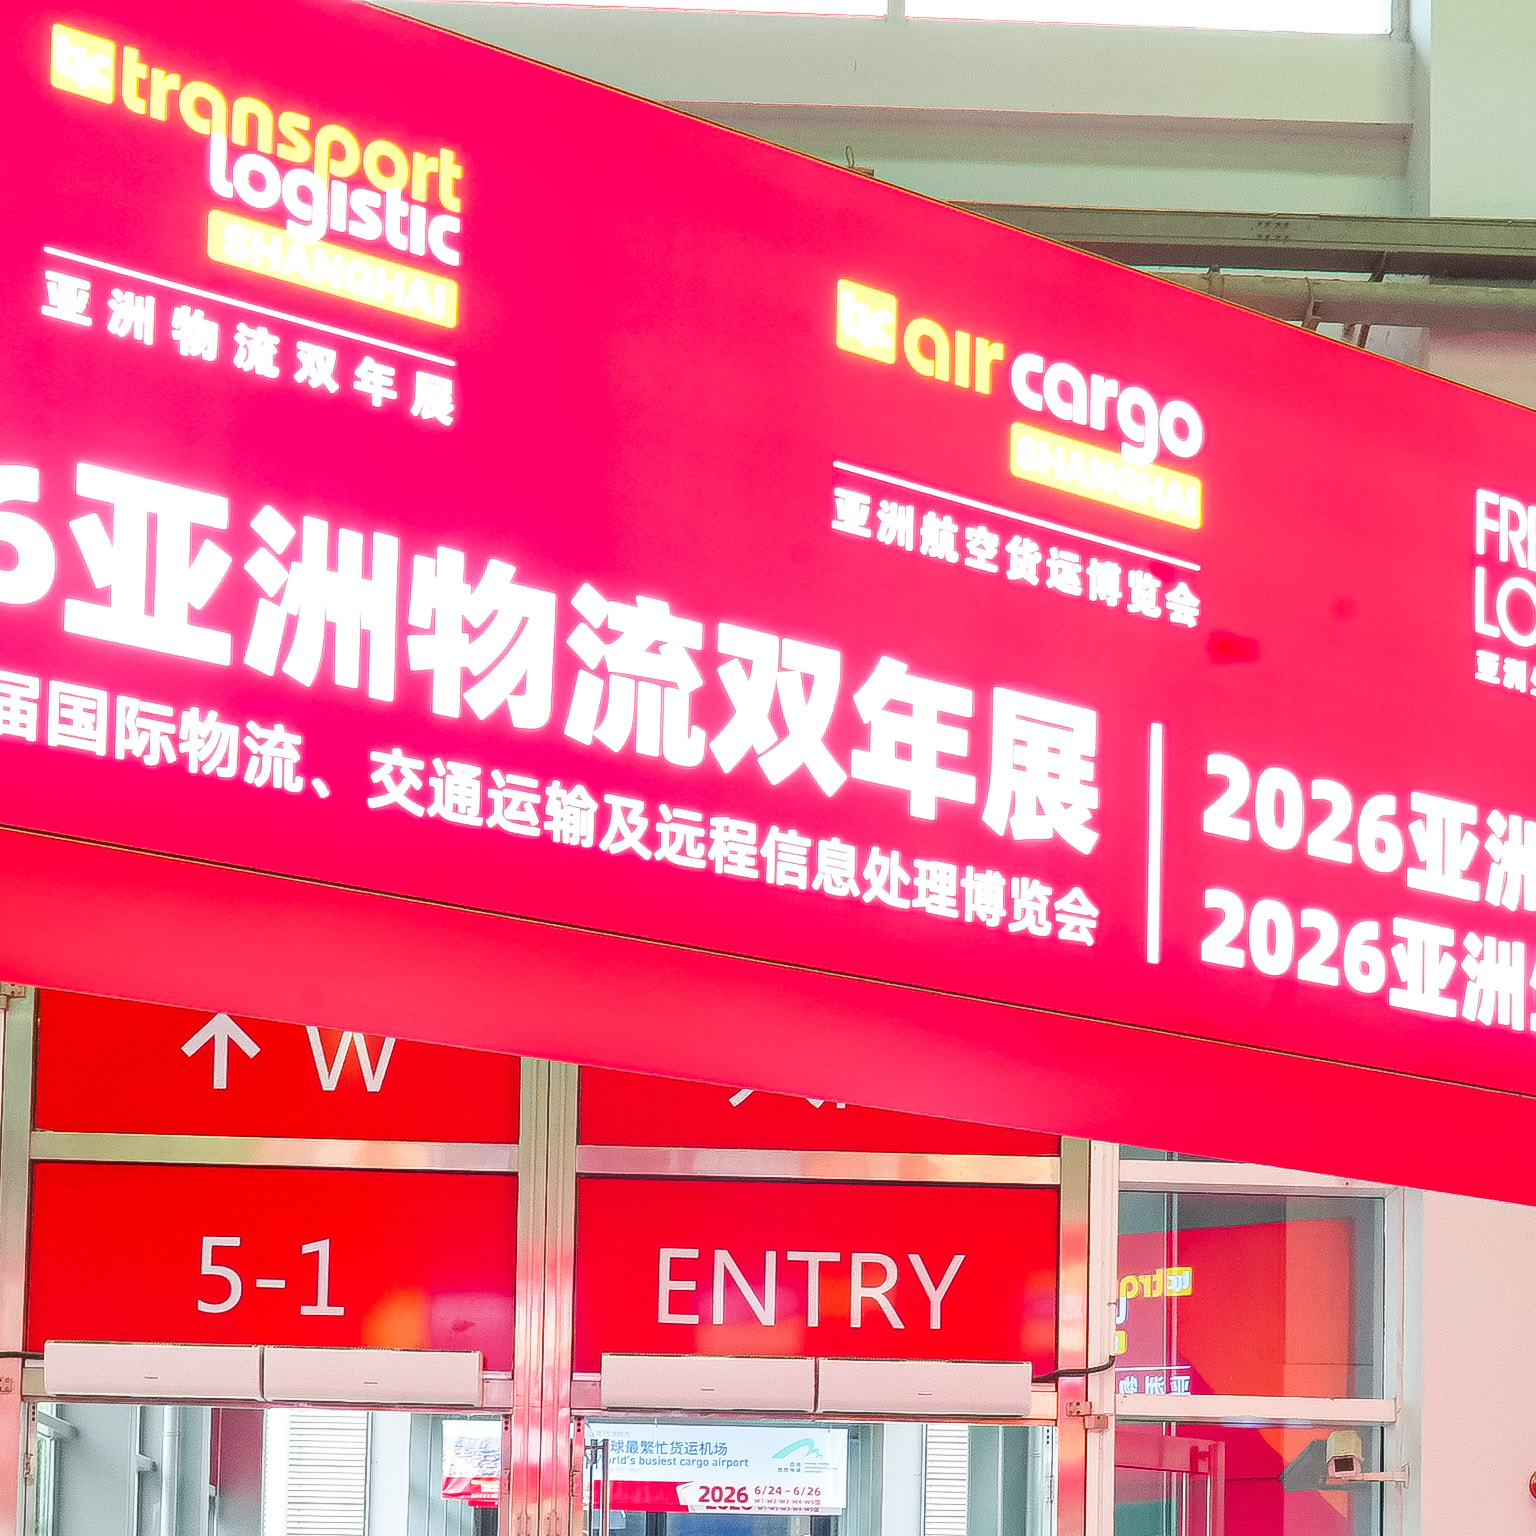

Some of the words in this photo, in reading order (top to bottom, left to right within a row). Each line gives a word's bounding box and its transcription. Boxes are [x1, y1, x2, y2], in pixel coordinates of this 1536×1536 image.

[120, 45, 463, 213] transport
[208, 132, 461, 267] logistic
[221, 221, 447, 320] SHANGHAI
[41, 269, 455, 426] 亚洲物流双年展
[903, 317, 1004, 395] air
[1010, 353, 1205, 465] cargo
[1016, 435, 1197, 519] SHANGHAI
[831, 487, 1201, 628] 亚洲航空货运博览会
[306, 1025, 397, 1092] W
[195, 1236, 346, 1317] 5-1
[655, 1247, 966, 1331] ENTRY
[596, 1455, 636, 1466] rld's
[639, 1455, 677, 1467] busiest
[679, 1457, 709, 1469] cargo
[712, 1457, 750, 1470] airport
[597, 1440, 728, 1456] 球最繁忙货运机场
[698, 1485, 750, 1504] 2026
[754, 1486, 782, 1496] 6/24
[793, 1486, 822, 1497] 6/26
